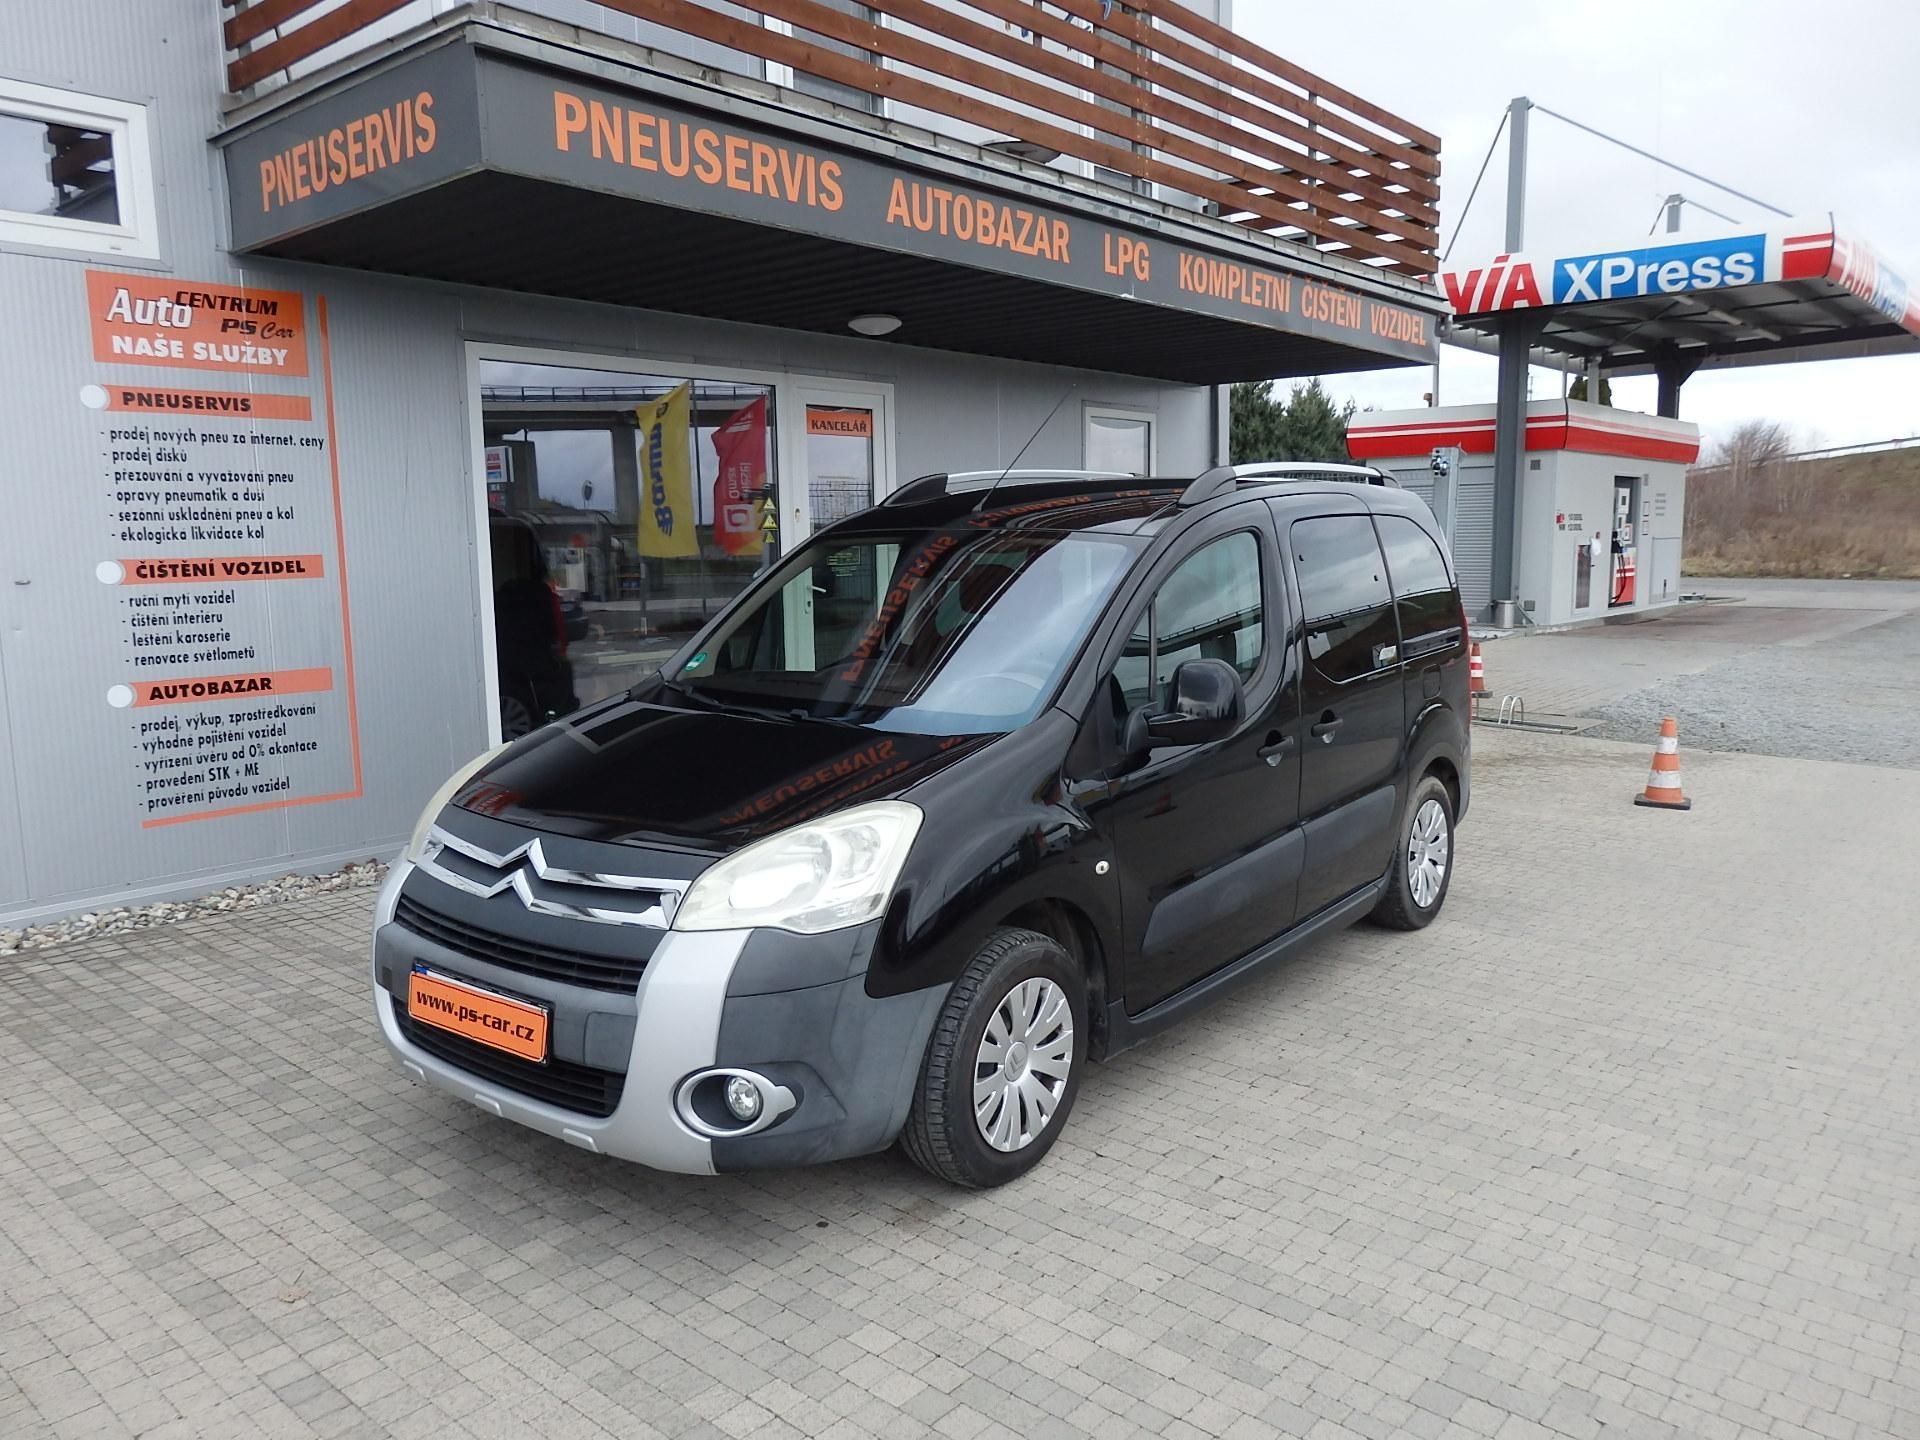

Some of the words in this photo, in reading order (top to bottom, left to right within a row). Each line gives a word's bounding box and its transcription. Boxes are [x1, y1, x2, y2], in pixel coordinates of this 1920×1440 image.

[260, 91, 436, 212] PNEUSERVIS
[553, 91, 844, 212] PNEUSERVIS
[886, 178, 1071, 264] AUTOBAZAR
[1104, 232, 1149, 282] LPG
[1178, 251, 1293, 314] KOMPLETNÍ
[1301, 277, 1362, 329] ČIŠTĚNÍ
[1370, 303, 1426, 346] VOZIDEL
[1562, 251, 1756, 304] XPress
[104, 287, 193, 329] Auto
[175, 291, 278, 316] CENTRUM
[220, 318, 258, 335] PS
[260, 321, 296, 340] Car
[112, 332, 185, 359] NAŠE
[193, 340, 288, 366] SLUŽBY
[122, 391, 251, 412] PNEUSERVIS
[811, 418, 867, 433] KANCELÁŘ
[110, 426, 149, 444] prodej
[153, 428, 197, 445] nových
[201, 432, 229, 446] pneu
[233, 434, 246, 444] za
[250, 430, 297, 446] internet.
[299, 436, 325, 450] ceny
[112, 446, 152, 465] prodej
[114, 467, 183, 485] přezouvání
[187, 472, 194, 481] a
[268, 473, 294, 486] pneu
[116, 491, 160, 505] opravy
[165, 487, 227, 505] pneumatik
[232, 491, 239, 501] a
[168, 506, 232, 521] uskladnění
[236, 510, 263, 523] pneu
[266, 511, 273, 520] a
[277, 505, 294, 520] kol
[121, 526, 187, 545] ekologická
[191, 525, 244, 540] likvidace
[247, 524, 265, 540] kol
[136, 559, 215, 579] ČIŠTĚNÍ
[222, 560, 306, 576] VOZIDEL
[129, 593, 159, 607] ruční
[194, 589, 235, 605] vozidel
[131, 612, 169, 627] čištění
[132, 631, 173, 647] leštění
[176, 628, 231, 644] karoserie
[135, 652, 189, 666] renovace
[194, 645, 255, 662] světlometů
[149, 677, 273, 701] AUTOBAZAR
[229, 702, 317, 727] zprostředkování
[142, 733, 194, 755] výhodné
[198, 729, 245, 749] pojištění
[248, 722, 287, 740] vozidel
[232, 745, 245, 760] od
[249, 743, 265, 758] 0%
[269, 741, 318, 756] akontace
[146, 771, 205, 794] provedení
[208, 765, 231, 781] STK
[244, 762, 259, 777] ME
[148, 789, 205, 813] prověření
[208, 782, 249, 803] původu
[252, 776, 290, 793] vozidel
[416, 991, 536, 1042] www.ps-car.cz
